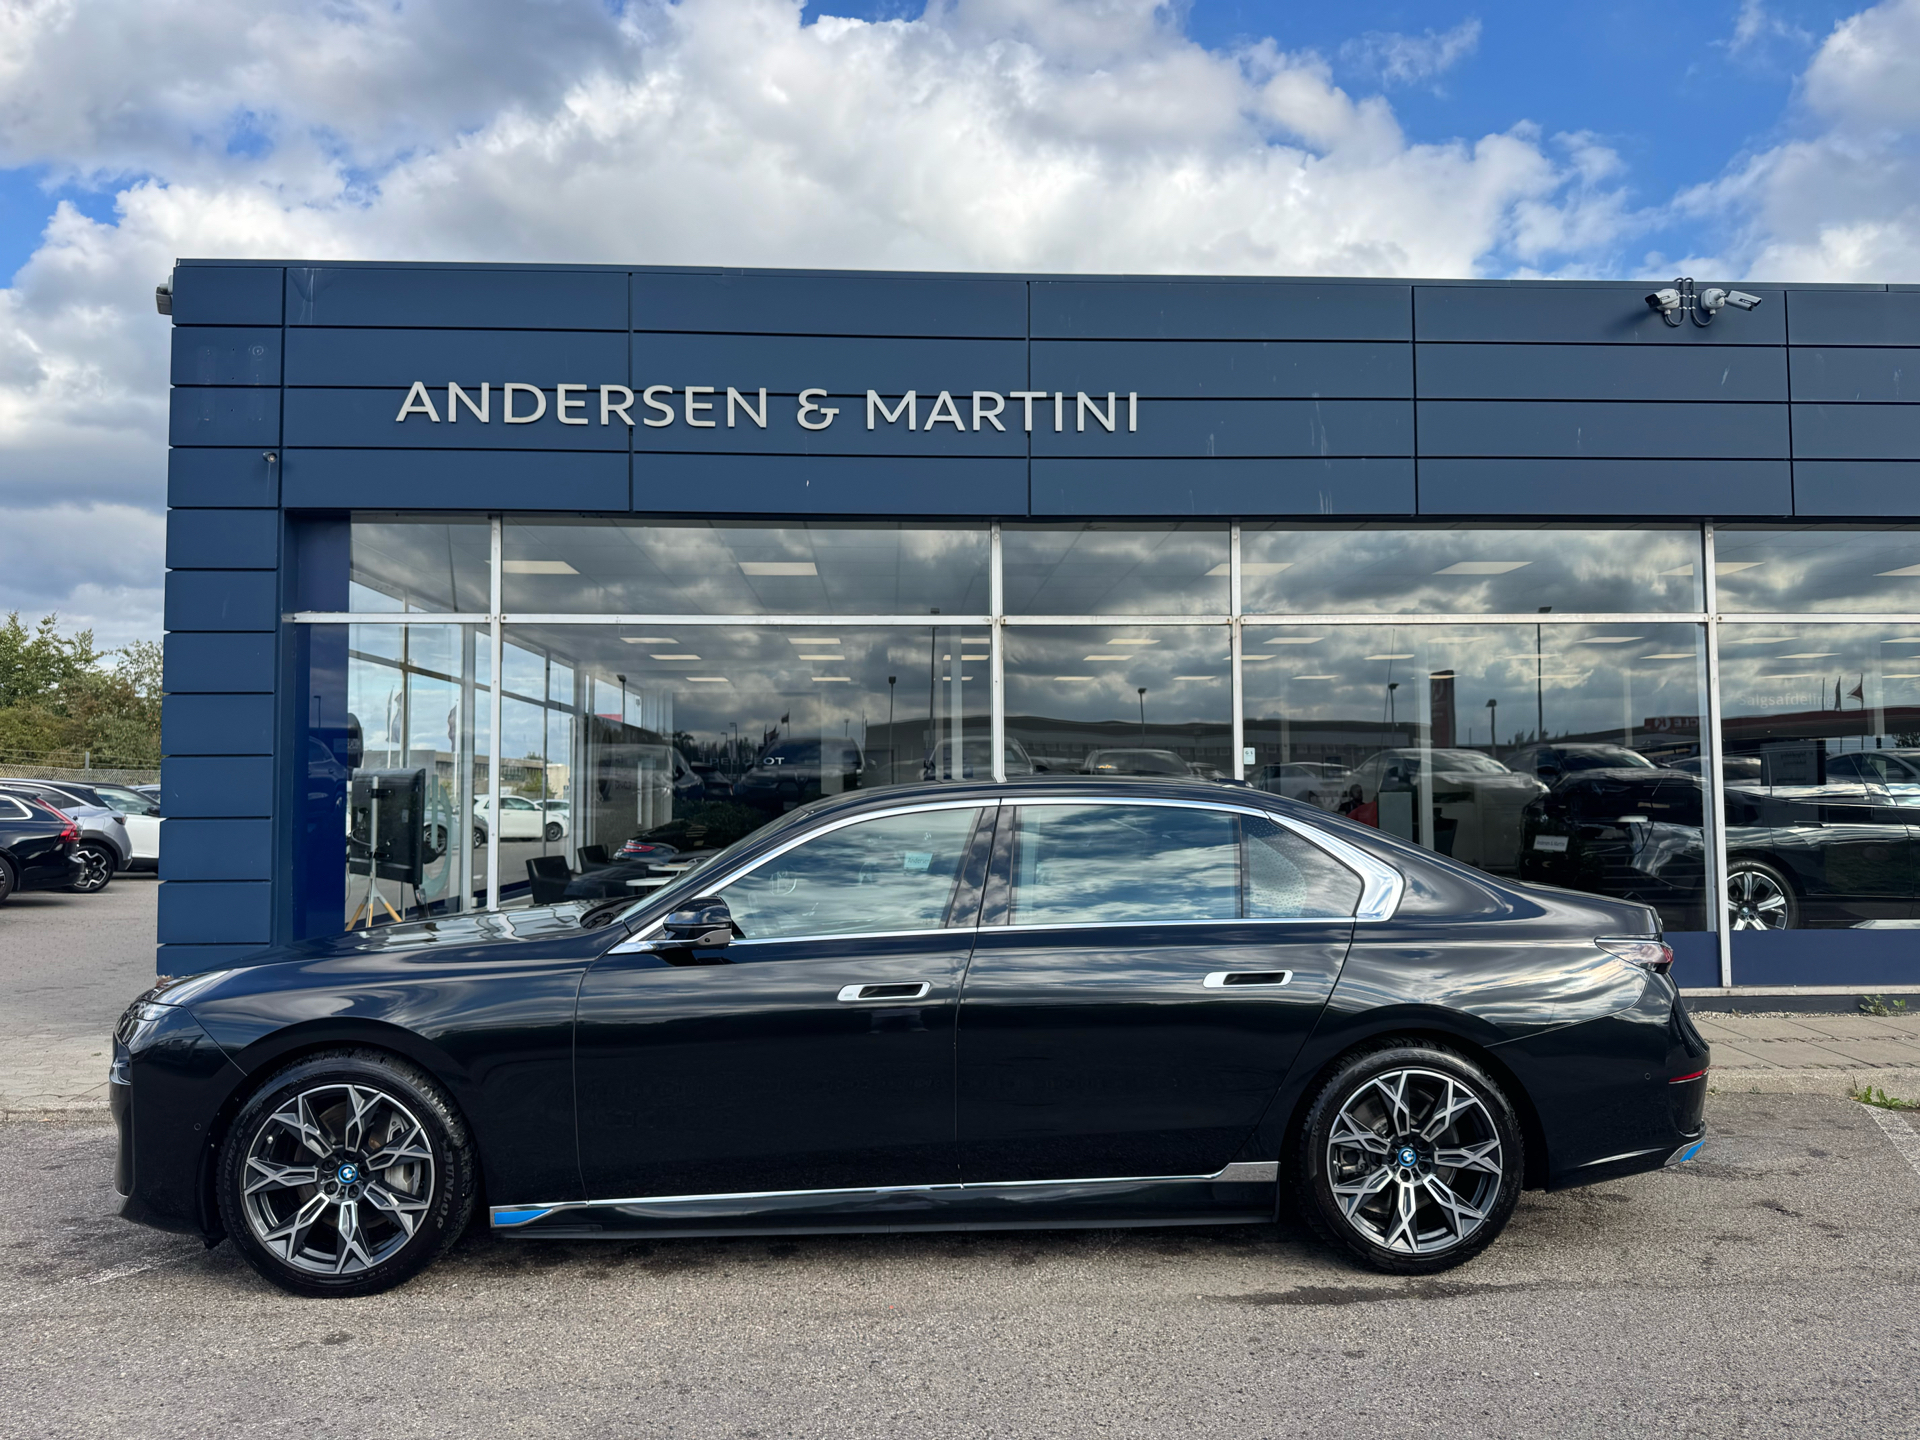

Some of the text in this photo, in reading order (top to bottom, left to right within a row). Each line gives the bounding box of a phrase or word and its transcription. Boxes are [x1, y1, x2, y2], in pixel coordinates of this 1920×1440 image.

[395, 381, 1138, 432] ANDERSEN & MARTINI
[1739, 692, 1835, 709] Salgsafdeling
[709, 756, 785, 766] PEUGEOT
[436, 1150, 454, 1229] DUNLOP
